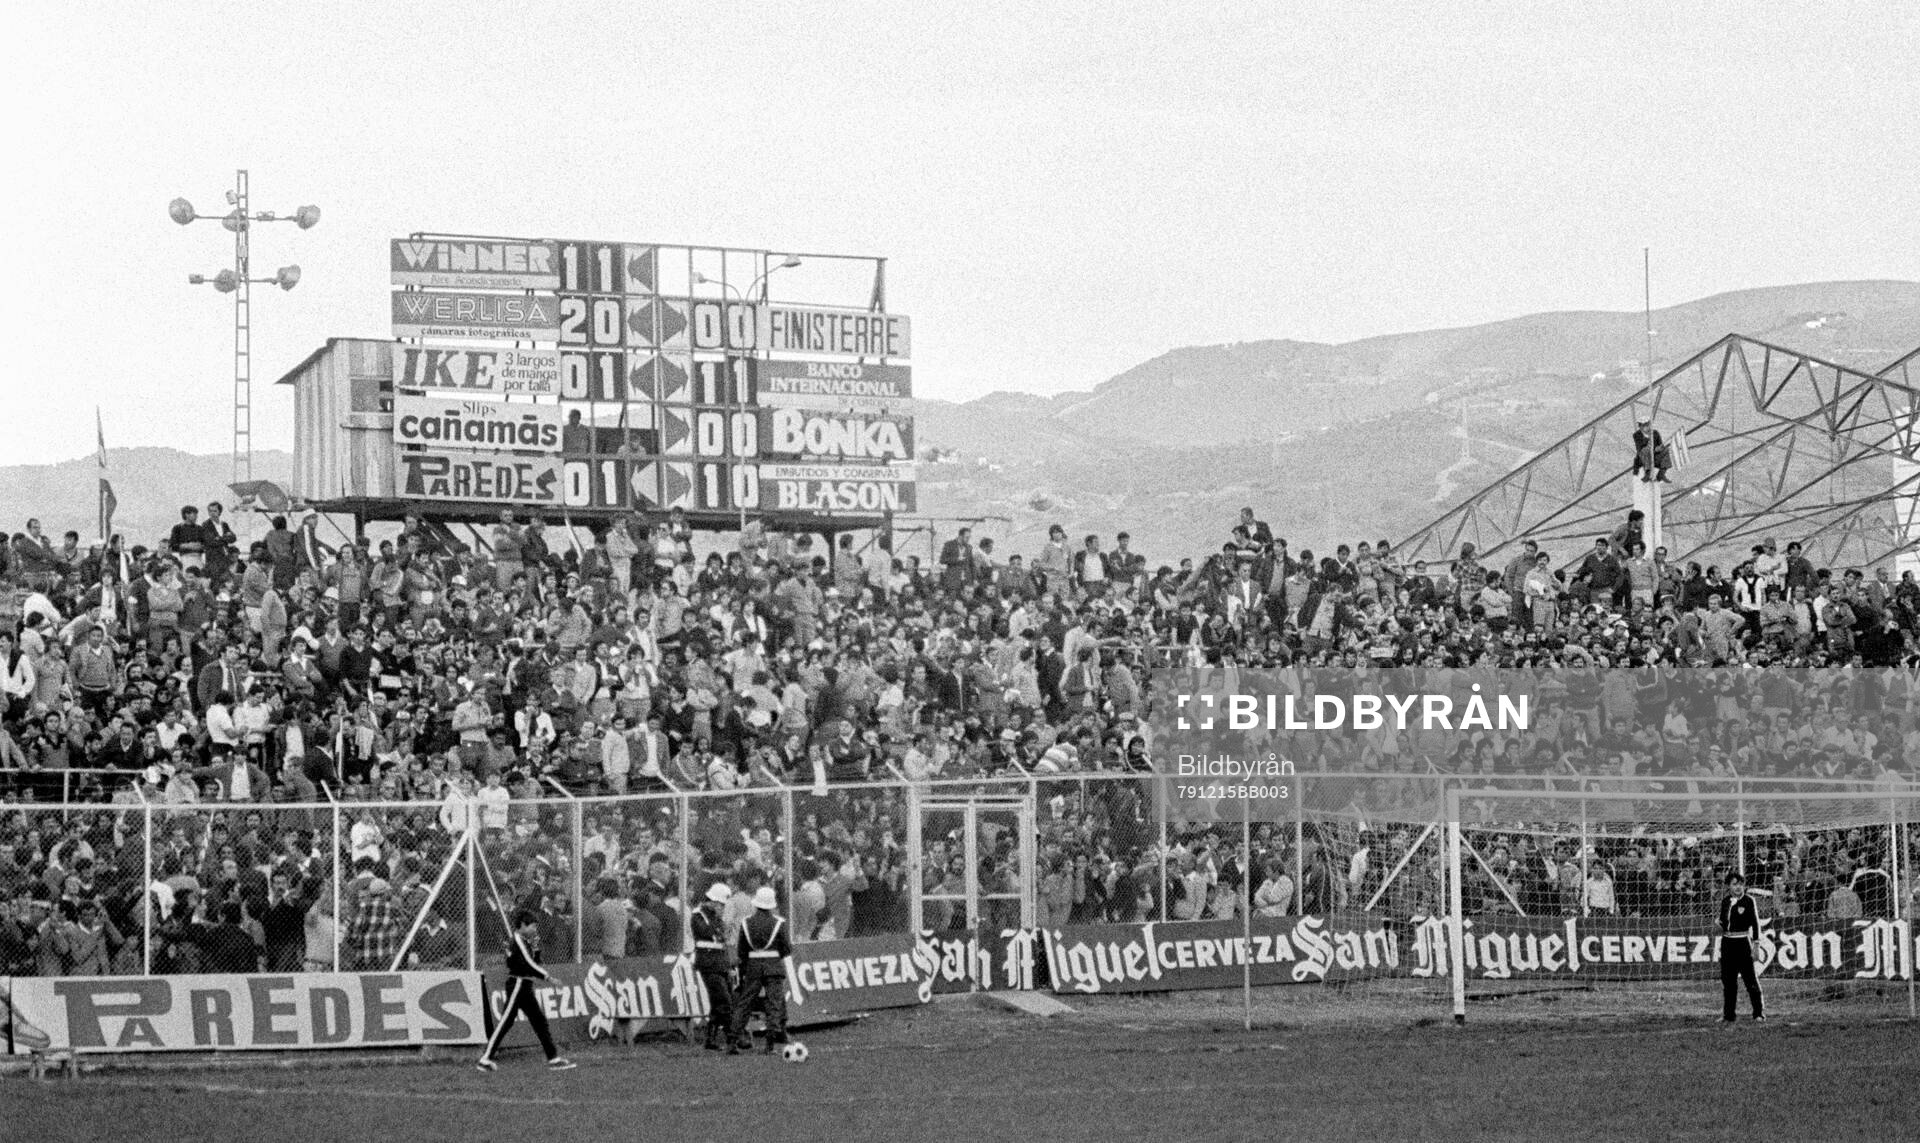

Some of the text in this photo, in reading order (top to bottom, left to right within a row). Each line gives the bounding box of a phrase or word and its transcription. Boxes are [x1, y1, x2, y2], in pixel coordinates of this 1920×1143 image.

[399, 296, 549, 323] WERLISA
[770, 310, 899, 356] FINISTERRE
[399, 349, 498, 389] IKE
[501, 366, 558, 384] de manga
[505, 352, 556, 372] 3 largos
[807, 363, 863, 379] BANCO
[503, 379, 552, 393] por talla
[770, 377, 901, 397] INTERNACIONAL
[462, 401, 498, 416] Slips
[772, 408, 908, 459] BONKA
[401, 455, 558, 500] PAREDES
[775, 467, 901, 480] EMBUTIDOS Y CONSERVAS
[798, 954, 918, 993] CERVEZA
[911, 929, 991, 1002] San
[1159, 934, 1296, 969] CERVEZA
[1291, 914, 1398, 983] San
[54, 976, 473, 1048] PAREDES
[583, 962, 663, 1040] San
